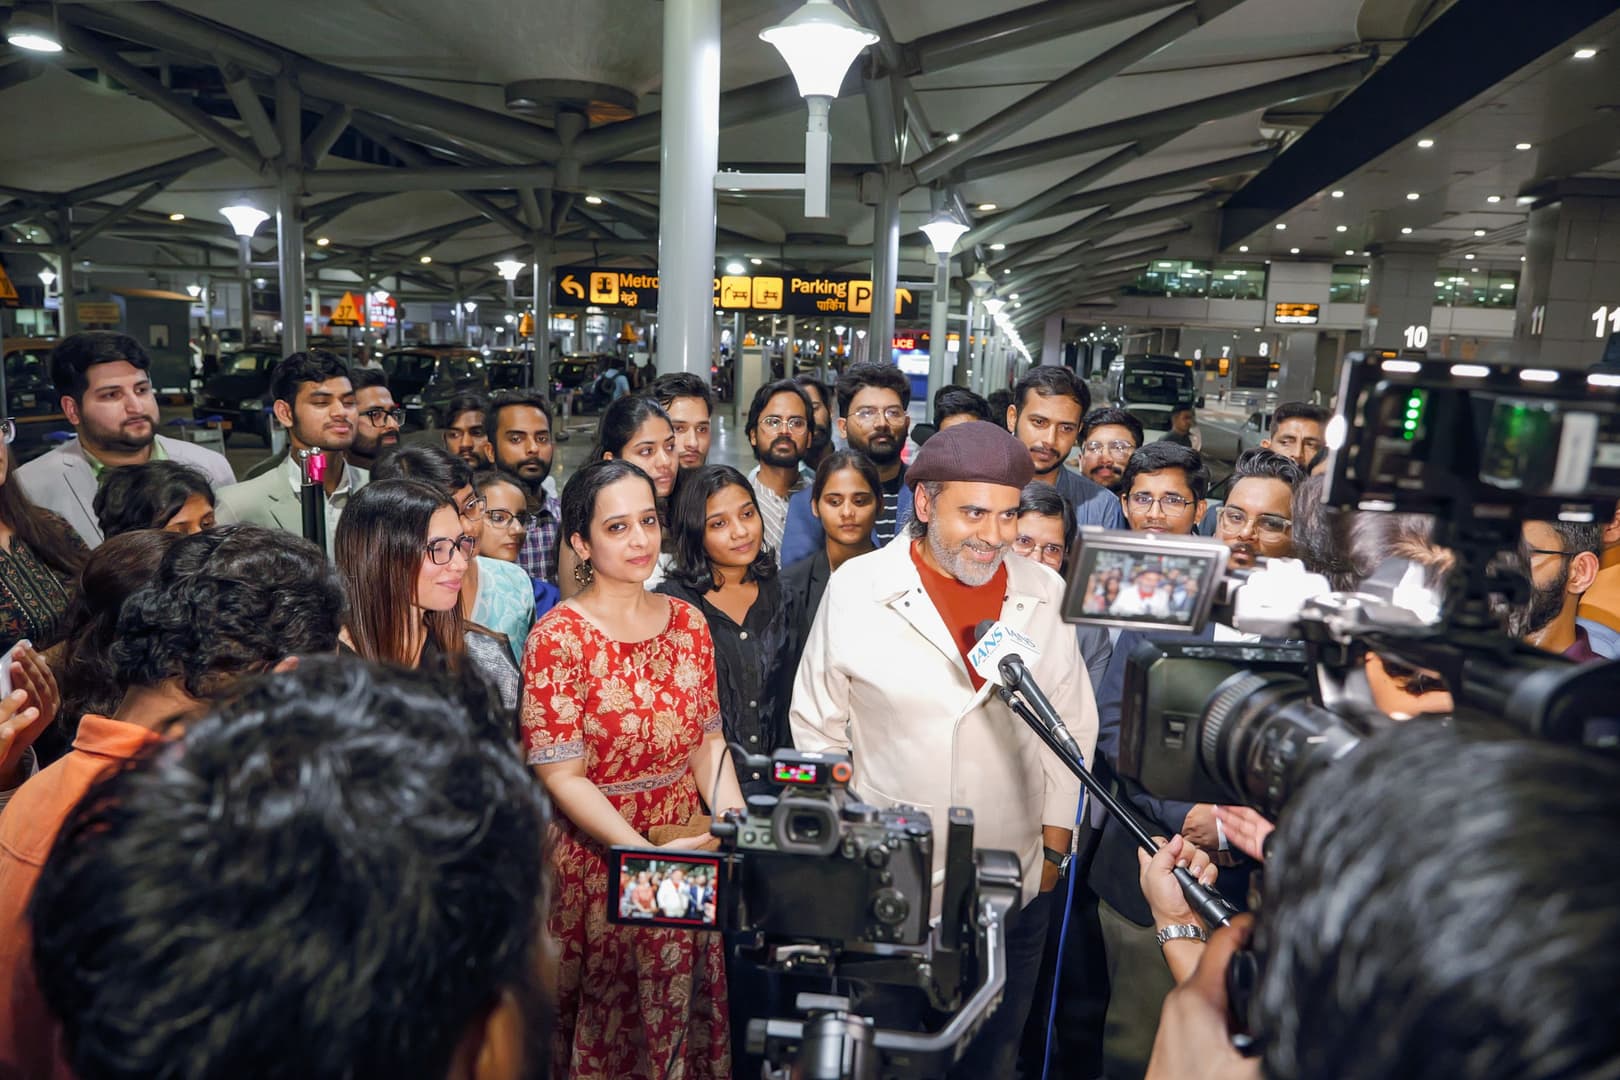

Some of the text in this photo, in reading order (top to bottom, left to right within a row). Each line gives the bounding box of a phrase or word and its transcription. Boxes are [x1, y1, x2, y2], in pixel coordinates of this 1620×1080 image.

[620, 272, 659, 288] Metro
[791, 277, 871, 306] Parking P
[891, 338, 914, 349] LICE
[1404, 325, 1428, 348] 10
[1221, 346, 1231, 358] 7
[1258, 342, 1269, 357] 8
[972, 626, 1003, 667] IANS
